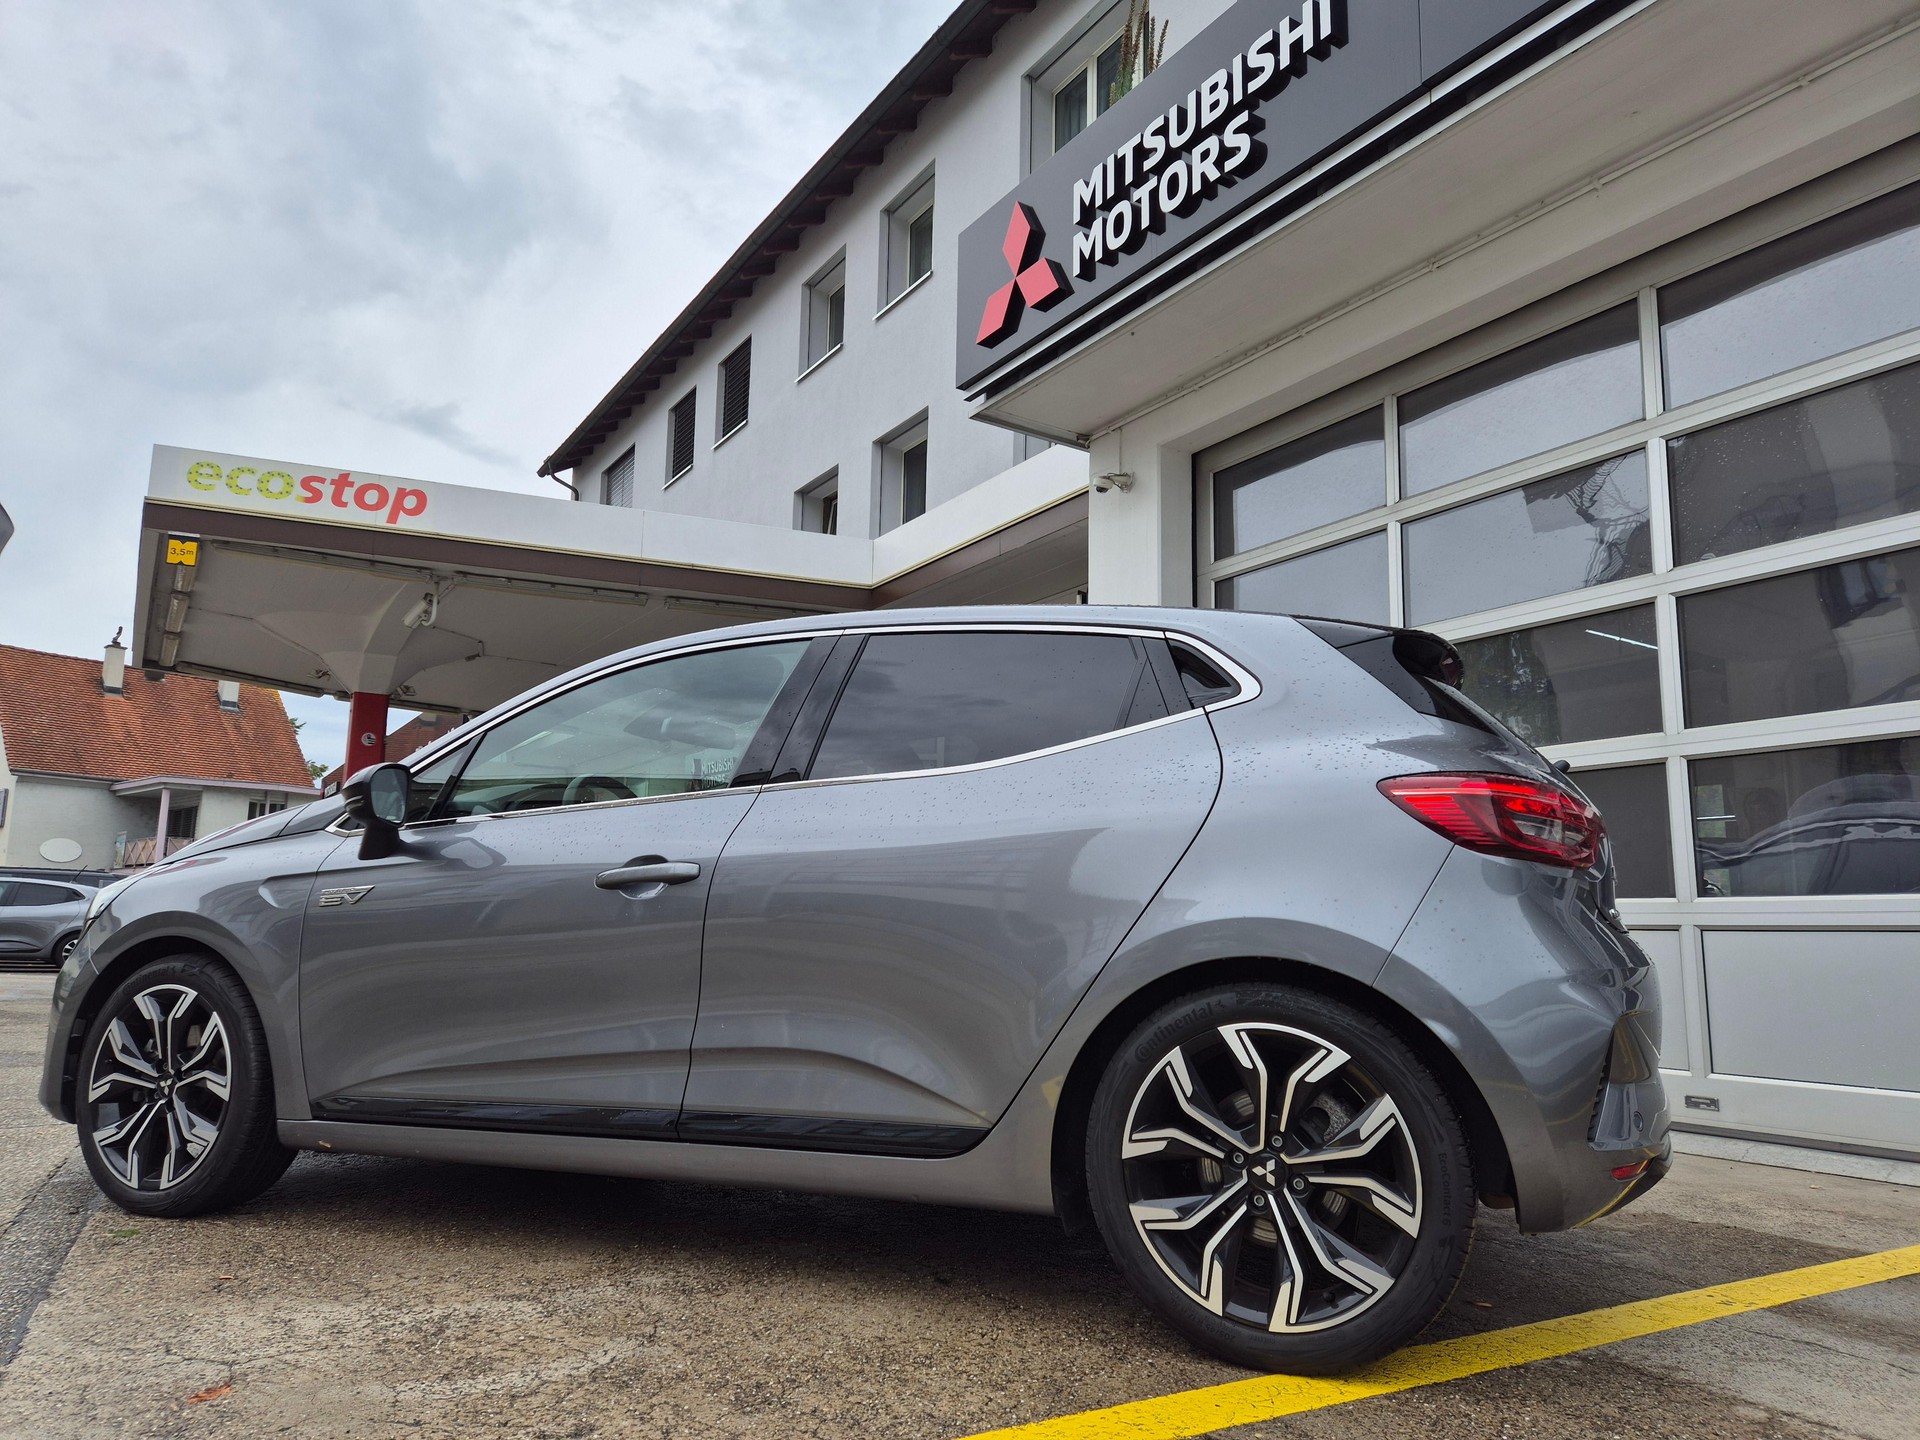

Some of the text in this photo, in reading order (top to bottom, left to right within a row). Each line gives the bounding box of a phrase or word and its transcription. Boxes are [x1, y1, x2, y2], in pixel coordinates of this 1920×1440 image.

[1073, 0, 1332, 225] MITSUBISHI
[1072, 110, 1252, 278] MOTORS
[186, 461, 428, 525] ecostop
[1135, 1002, 1215, 1063] Continental
[1438, 1152, 1451, 1217] EcoContact
